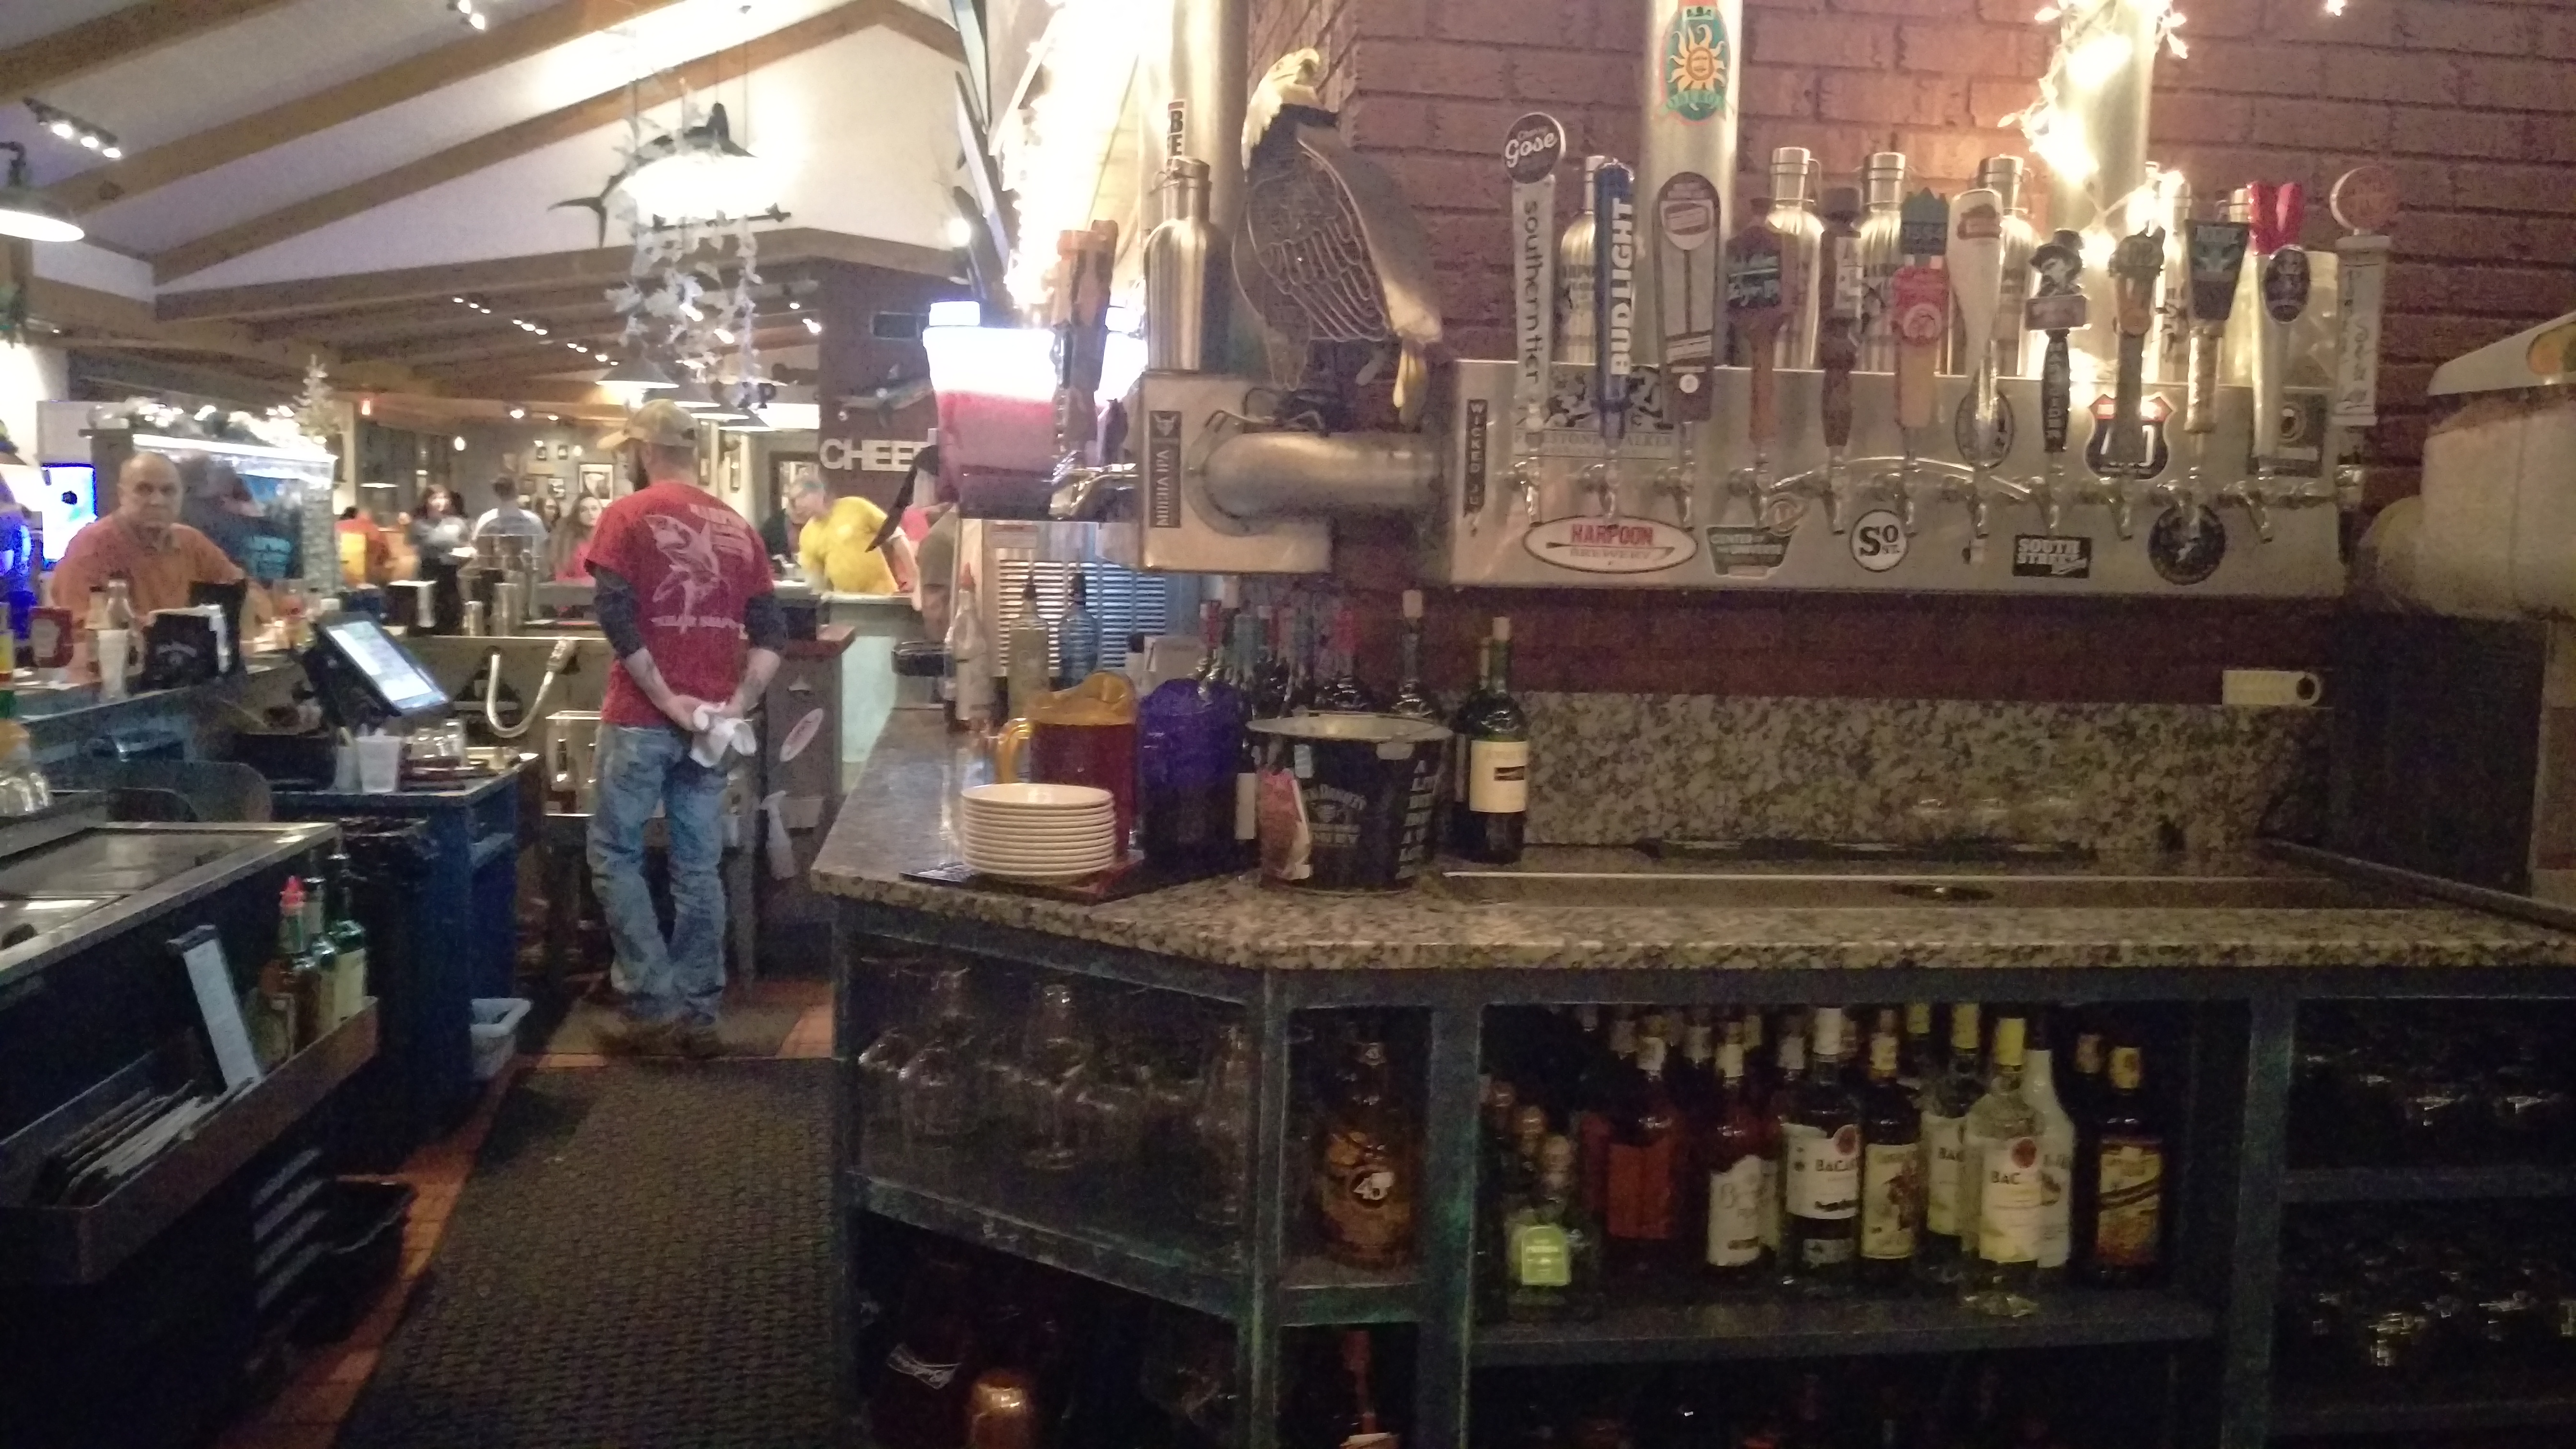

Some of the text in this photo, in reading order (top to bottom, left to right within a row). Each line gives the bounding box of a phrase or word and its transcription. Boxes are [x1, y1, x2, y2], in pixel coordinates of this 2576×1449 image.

[1610, 197, 1633, 375] BUD LIGHT
[1570, 524, 1654, 545] HARPOON
[2018, 538, 2081, 553] SOUTH
